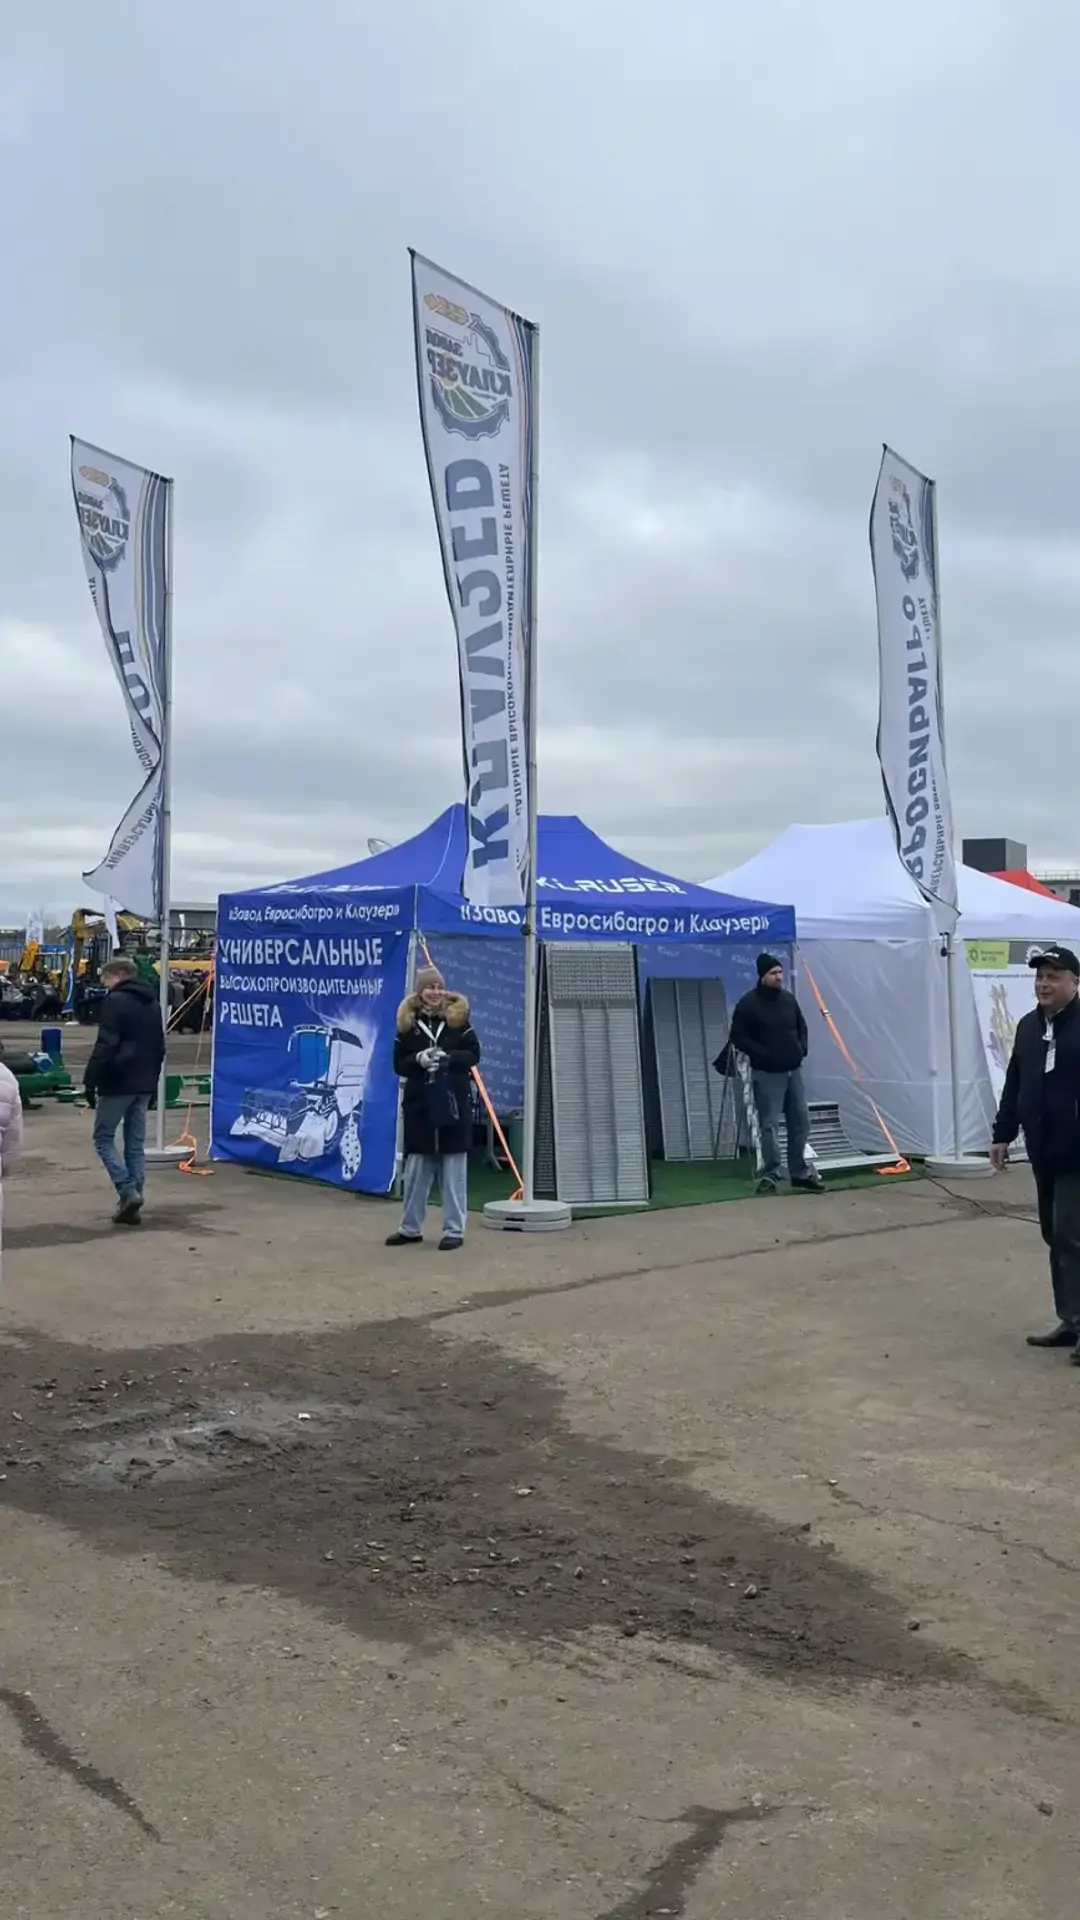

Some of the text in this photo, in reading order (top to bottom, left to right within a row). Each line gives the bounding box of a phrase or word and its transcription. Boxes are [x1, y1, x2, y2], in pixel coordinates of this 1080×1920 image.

[264, 904, 334, 923] Евросибагро
[336, 907, 343, 919] и
[460, 904, 770, 936] «Заво Евросибагро и Клаузер»
[219, 938, 383, 966] УНИВЕРСАЛЬНЫЕ
[219, 974, 384, 996] ВЫСОКОПРОИЗВОДИТЕЛЬНЫЕ
[219, 1001, 283, 1028] РЕШЕТА
